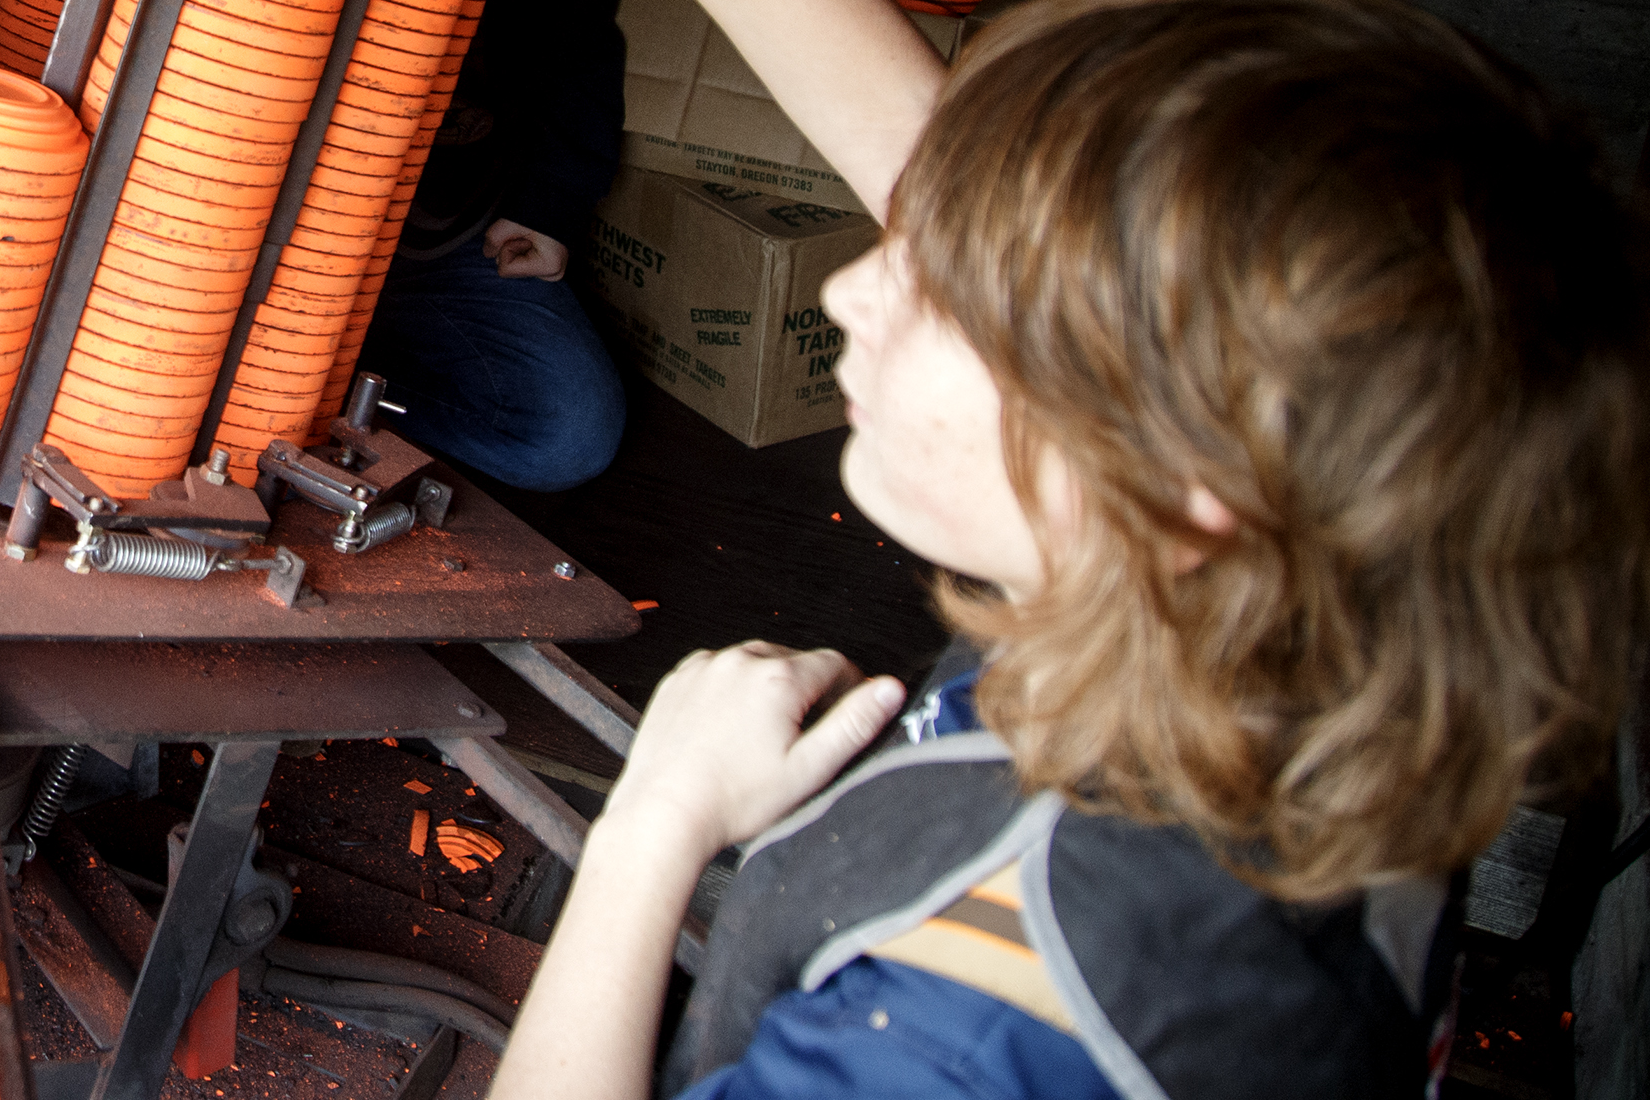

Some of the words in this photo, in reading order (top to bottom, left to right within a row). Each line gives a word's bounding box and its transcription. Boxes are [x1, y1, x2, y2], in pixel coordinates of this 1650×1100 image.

[684, 142, 715, 158] TARGETS
[717, 149, 732, 160] MAY
[747, 155, 783, 170] HARMFUL
[741, 169, 779, 186] OREGON
[781, 175, 813, 192] 97383
[590, 218, 667, 274] THWEST
[588, 240, 645, 288] RGETS
[690, 308, 752, 325] EXTREMELY
[697, 330, 742, 346] FRAGILE
[796, 327, 844, 355] TAR
[695, 358, 726, 388] TARGETS
[796, 385, 811, 400] 135
